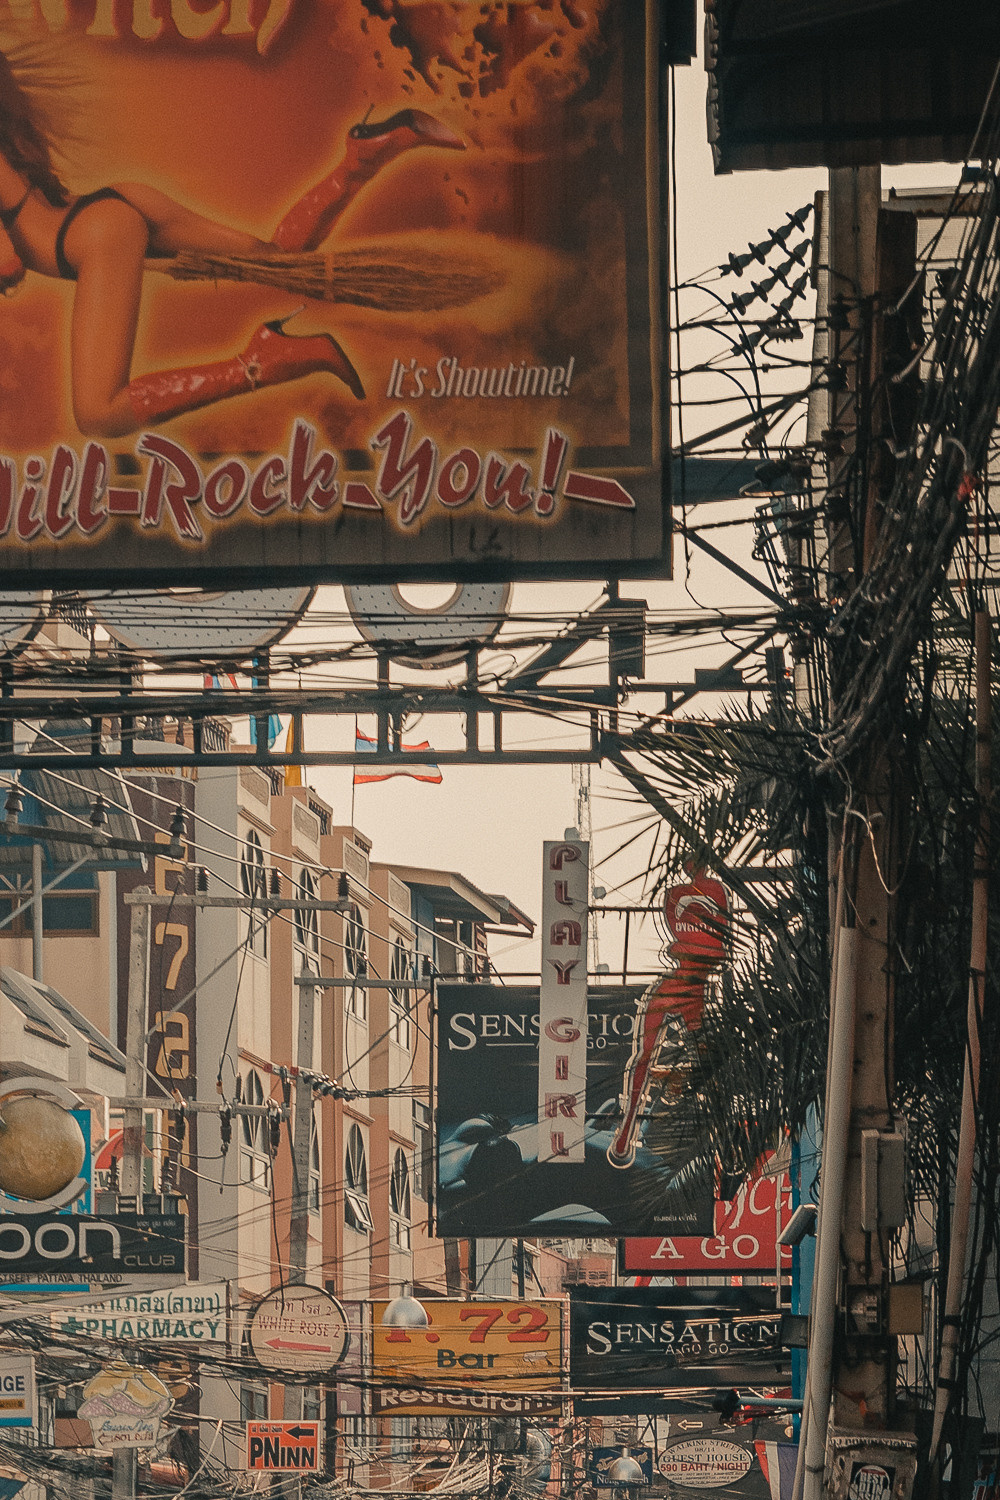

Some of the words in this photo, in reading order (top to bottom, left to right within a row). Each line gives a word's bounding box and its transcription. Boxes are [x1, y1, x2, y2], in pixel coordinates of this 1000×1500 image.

[387, 357, 426, 398] It's
[430, 356, 574, 398] Showtime!
[651, 1237, 684, 1259] A
[701, 1234, 760, 1260] GO
[123, 1255, 176, 1267] CLUB
[37, 1273, 75, 1283] PATTAYA
[78, 1273, 123, 1283] THAILAND
[87, 1319, 220, 1338] PHARMACY
[258, 1315, 296, 1334] WHITE
[299, 1321, 330, 1337] ROSE
[333, 1324, 341, 1338] 2
[708, 1343, 729, 1355] GO
[437, 1348, 500, 1370] Bar
[667, 1439, 707, 1454] WALKING
[710, 1440, 743, 1454] STREET
[663, 1453, 702, 1463] GUEST
[707, 1453, 747, 1462] HOUSE
[660, 1463, 678, 1472] 590
[680, 1462, 709, 1472] BAHT
[717, 1461, 750, 1471] NIGHT
